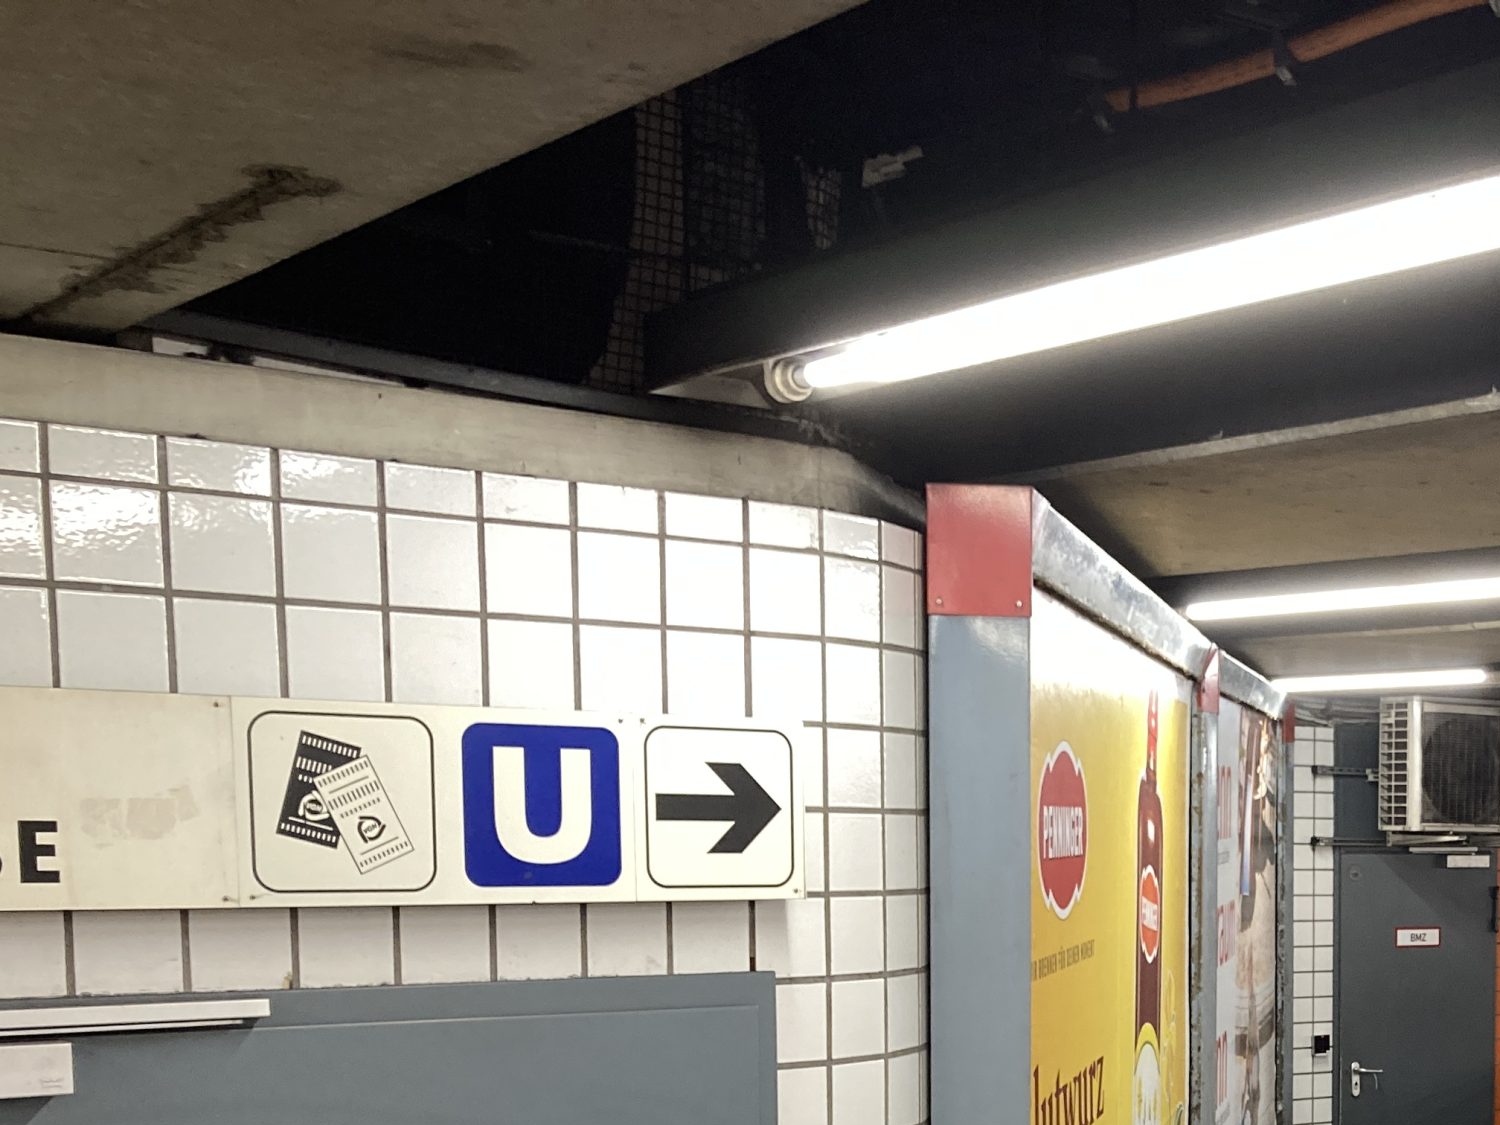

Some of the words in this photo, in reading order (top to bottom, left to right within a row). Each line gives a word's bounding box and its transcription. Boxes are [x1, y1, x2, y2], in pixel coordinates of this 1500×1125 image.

[492, 746, 592, 865] U
[1043, 805, 1084, 860] PENNINGER
[0, 820, 61, 883] E
[1410, 932, 1427, 942] BMZ
